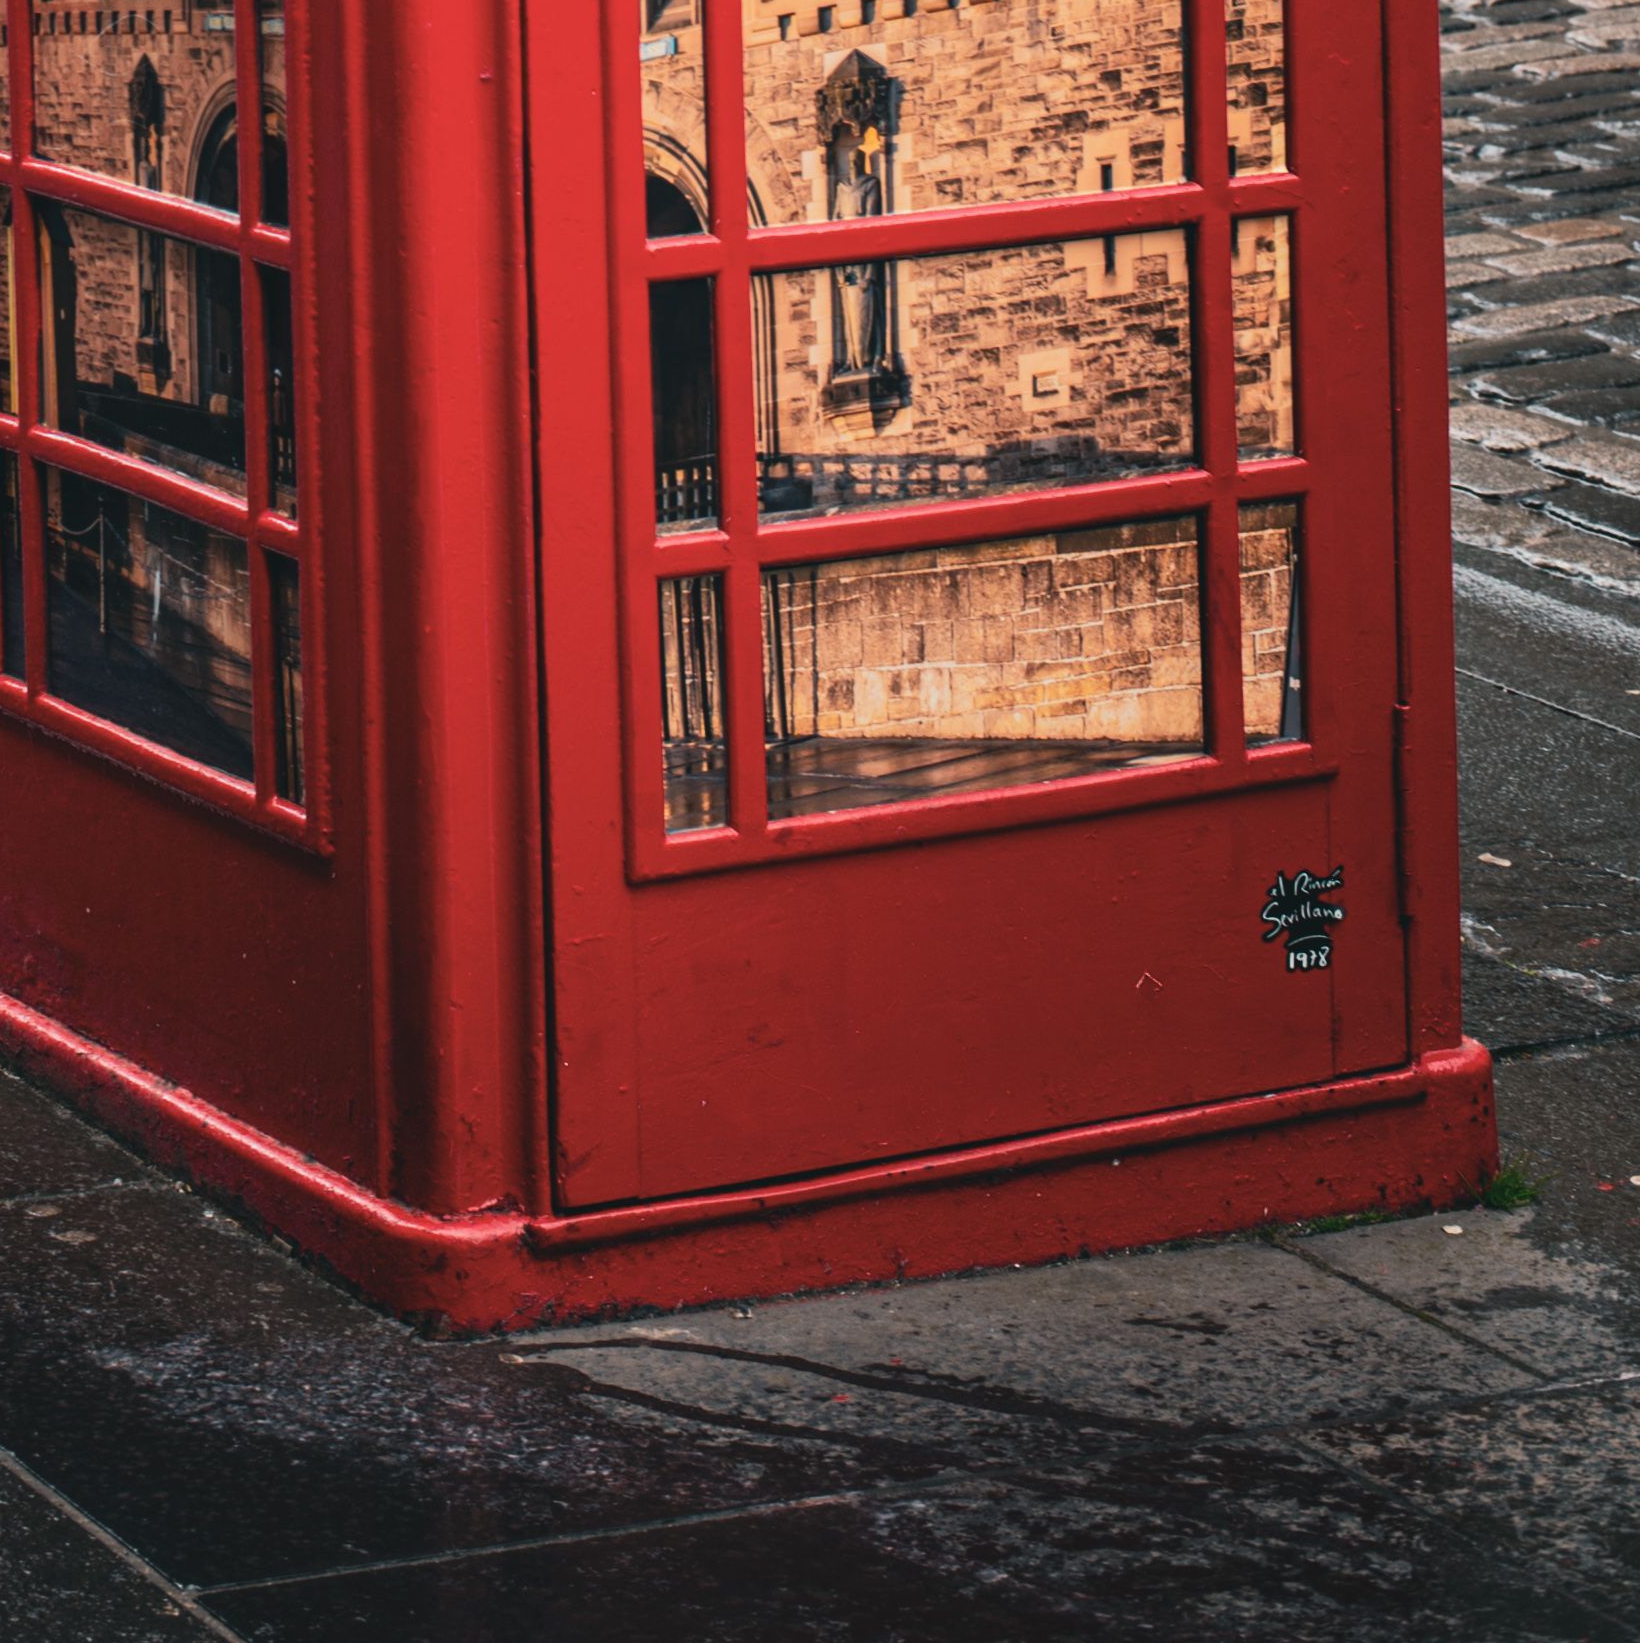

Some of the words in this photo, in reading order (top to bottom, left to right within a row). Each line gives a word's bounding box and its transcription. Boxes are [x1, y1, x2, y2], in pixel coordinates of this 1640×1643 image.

[1269, 875, 1286, 897] el
[1262, 901, 1344, 939] Sevillano
[1289, 946, 1330, 970] 1978
